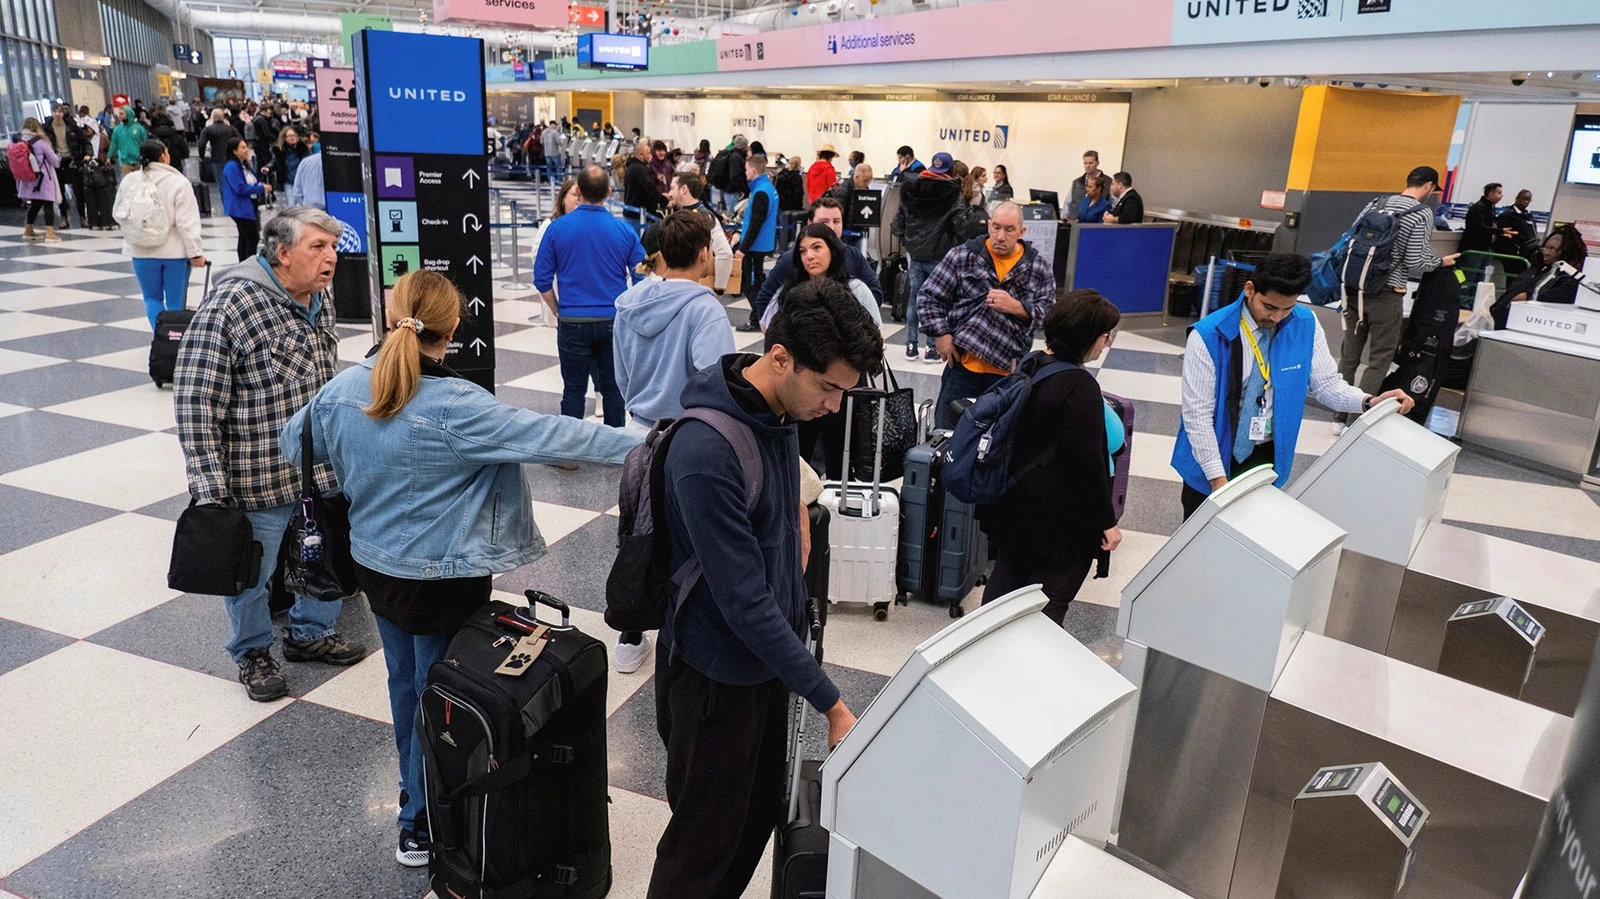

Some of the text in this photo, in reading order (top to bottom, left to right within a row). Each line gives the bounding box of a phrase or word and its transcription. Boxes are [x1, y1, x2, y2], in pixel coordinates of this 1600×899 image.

[485, 0, 535, 10] services
[1187, 0, 1289, 19] UNITED
[841, 31, 915, 50] Additional services
[598, 46, 631, 55] UNITED
[720, 48, 744, 60] UNITED
[388, 87, 466, 102] UNITED
[1047, 94, 1090, 102] STAR ALLIANCE
[671, 114, 690, 124] UNITED
[733, 118, 757, 128] UNITED
[817, 122, 850, 134] UNITED
[939, 128, 991, 143] UNITED
[421, 218, 449, 226] Check-in
[1526, 316, 1572, 330] UNITED
[1559, 819, 1598, 899] your
